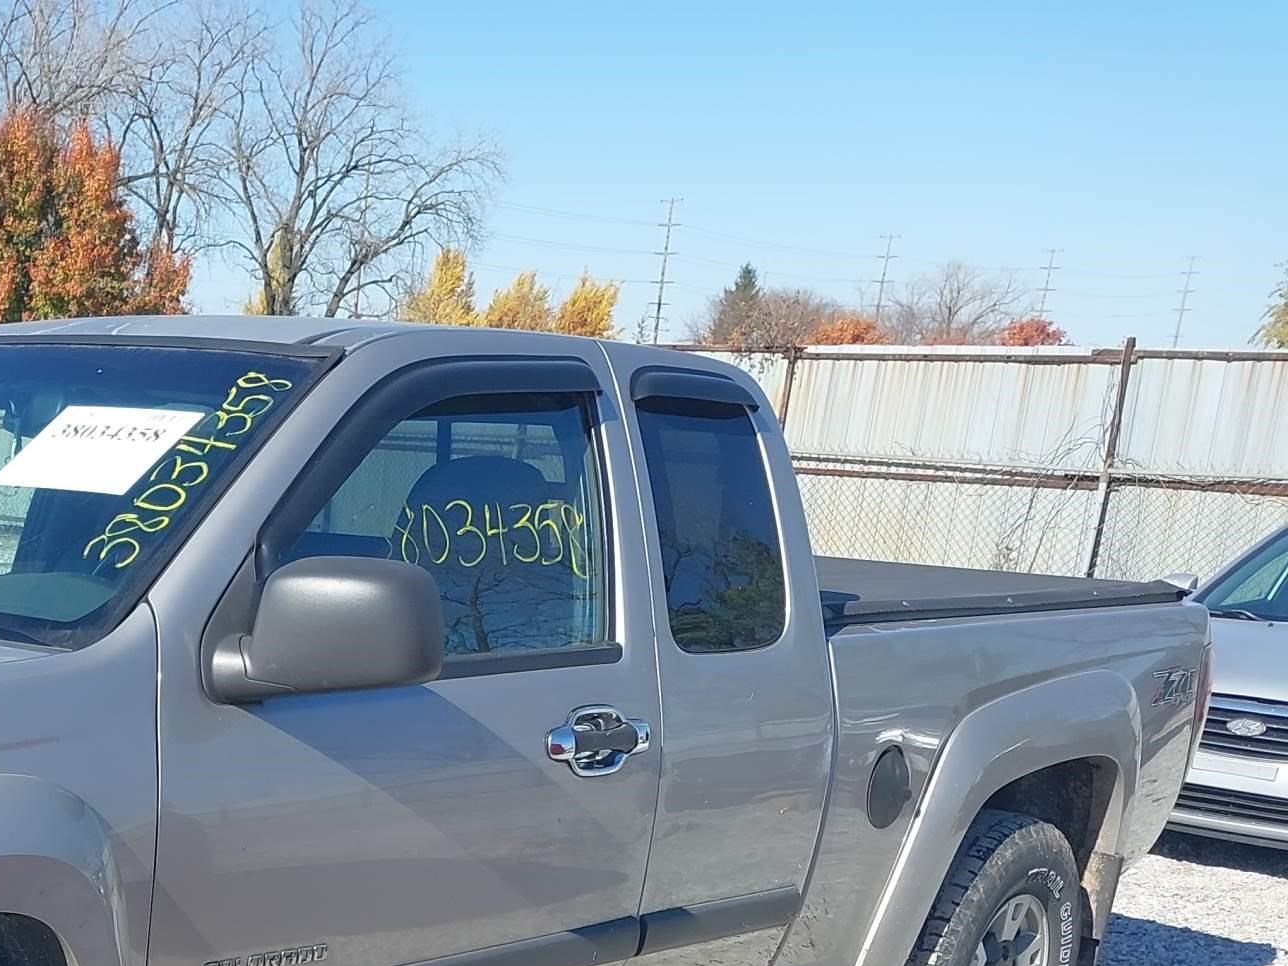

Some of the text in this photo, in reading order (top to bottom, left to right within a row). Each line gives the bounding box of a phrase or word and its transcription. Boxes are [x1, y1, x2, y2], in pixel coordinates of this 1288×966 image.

[50, 423, 166, 442] 38034358
[83, 371, 292, 568] 38034358
[383, 499, 589, 579] 8034358
[1027, 867, 1064, 900] TRAIL
